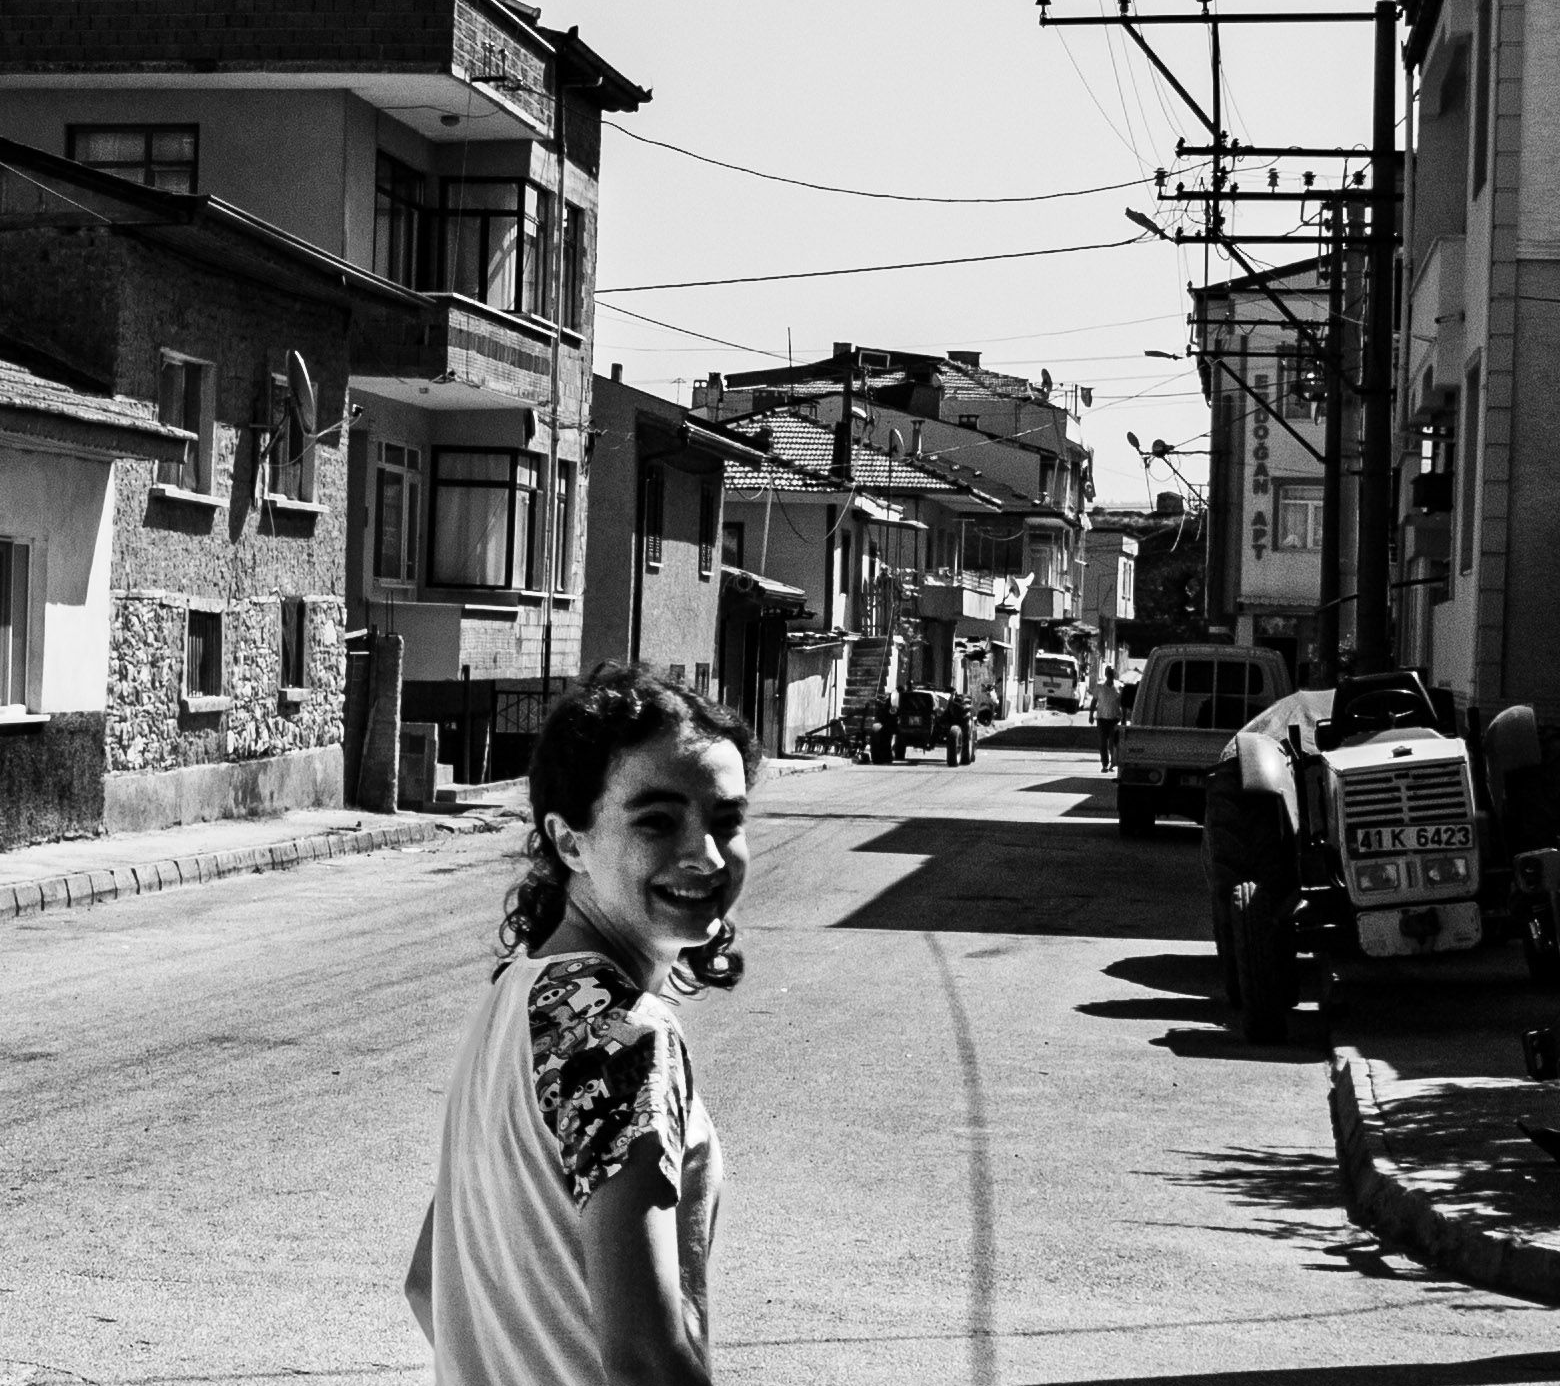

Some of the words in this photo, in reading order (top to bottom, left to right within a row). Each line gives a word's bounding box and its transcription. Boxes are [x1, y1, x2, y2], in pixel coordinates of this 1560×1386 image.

[1251, 510, 1268, 561] APT
[1359, 828, 1383, 850] 41
[1390, 827, 1407, 849] K
[1416, 825, 1472, 848] 6423
